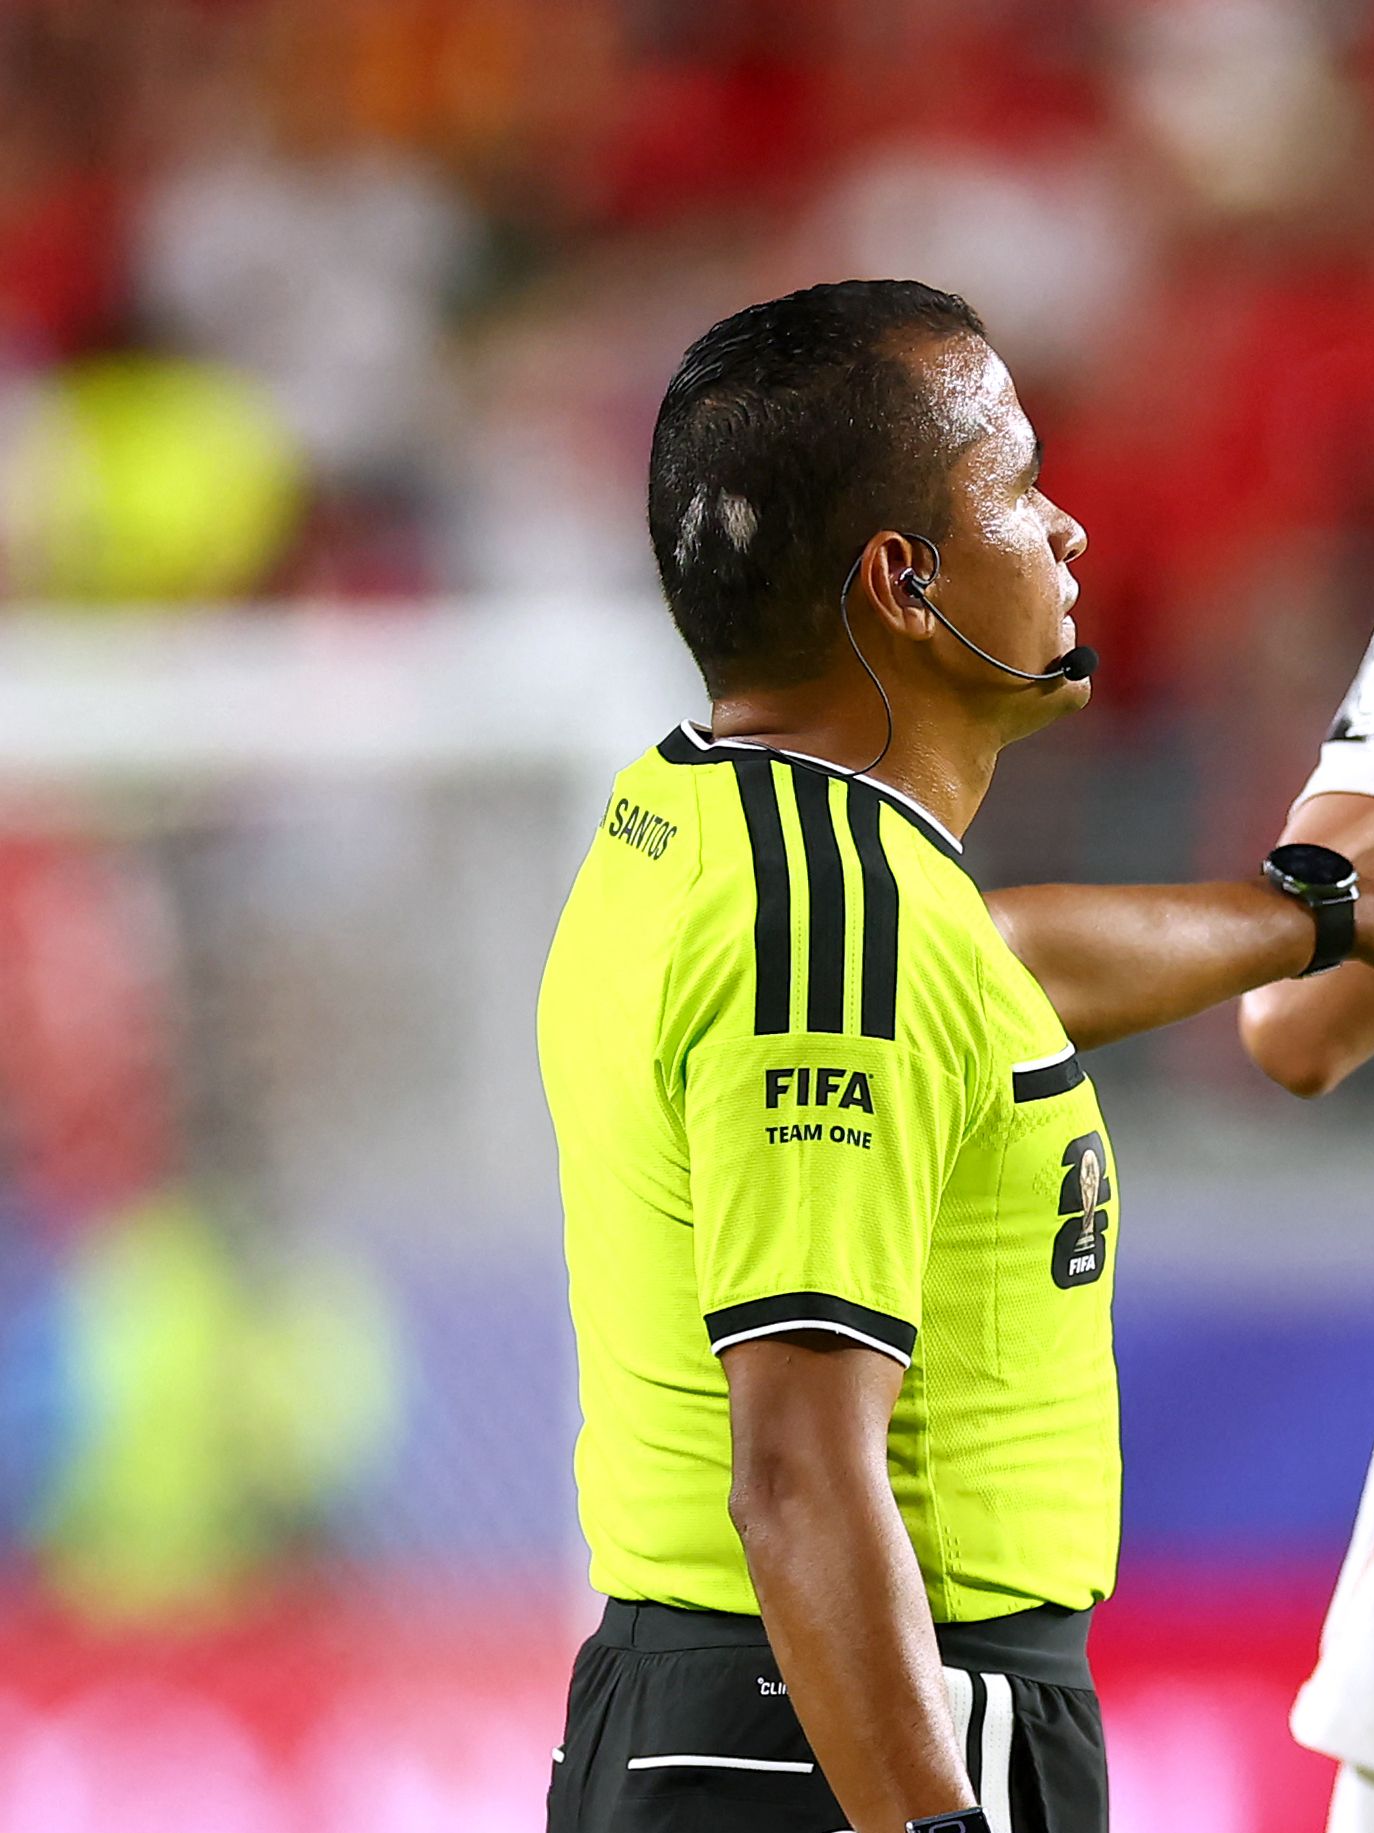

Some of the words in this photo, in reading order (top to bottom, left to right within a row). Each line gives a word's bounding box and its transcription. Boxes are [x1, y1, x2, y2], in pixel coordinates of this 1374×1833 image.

[609, 798, 677, 860] SANTOS
[765, 1067, 874, 1115] FIFA
[765, 1123, 822, 1144] TEAM
[829, 1125, 872, 1149] ONE
[1068, 1253, 1096, 1276] FIFA
